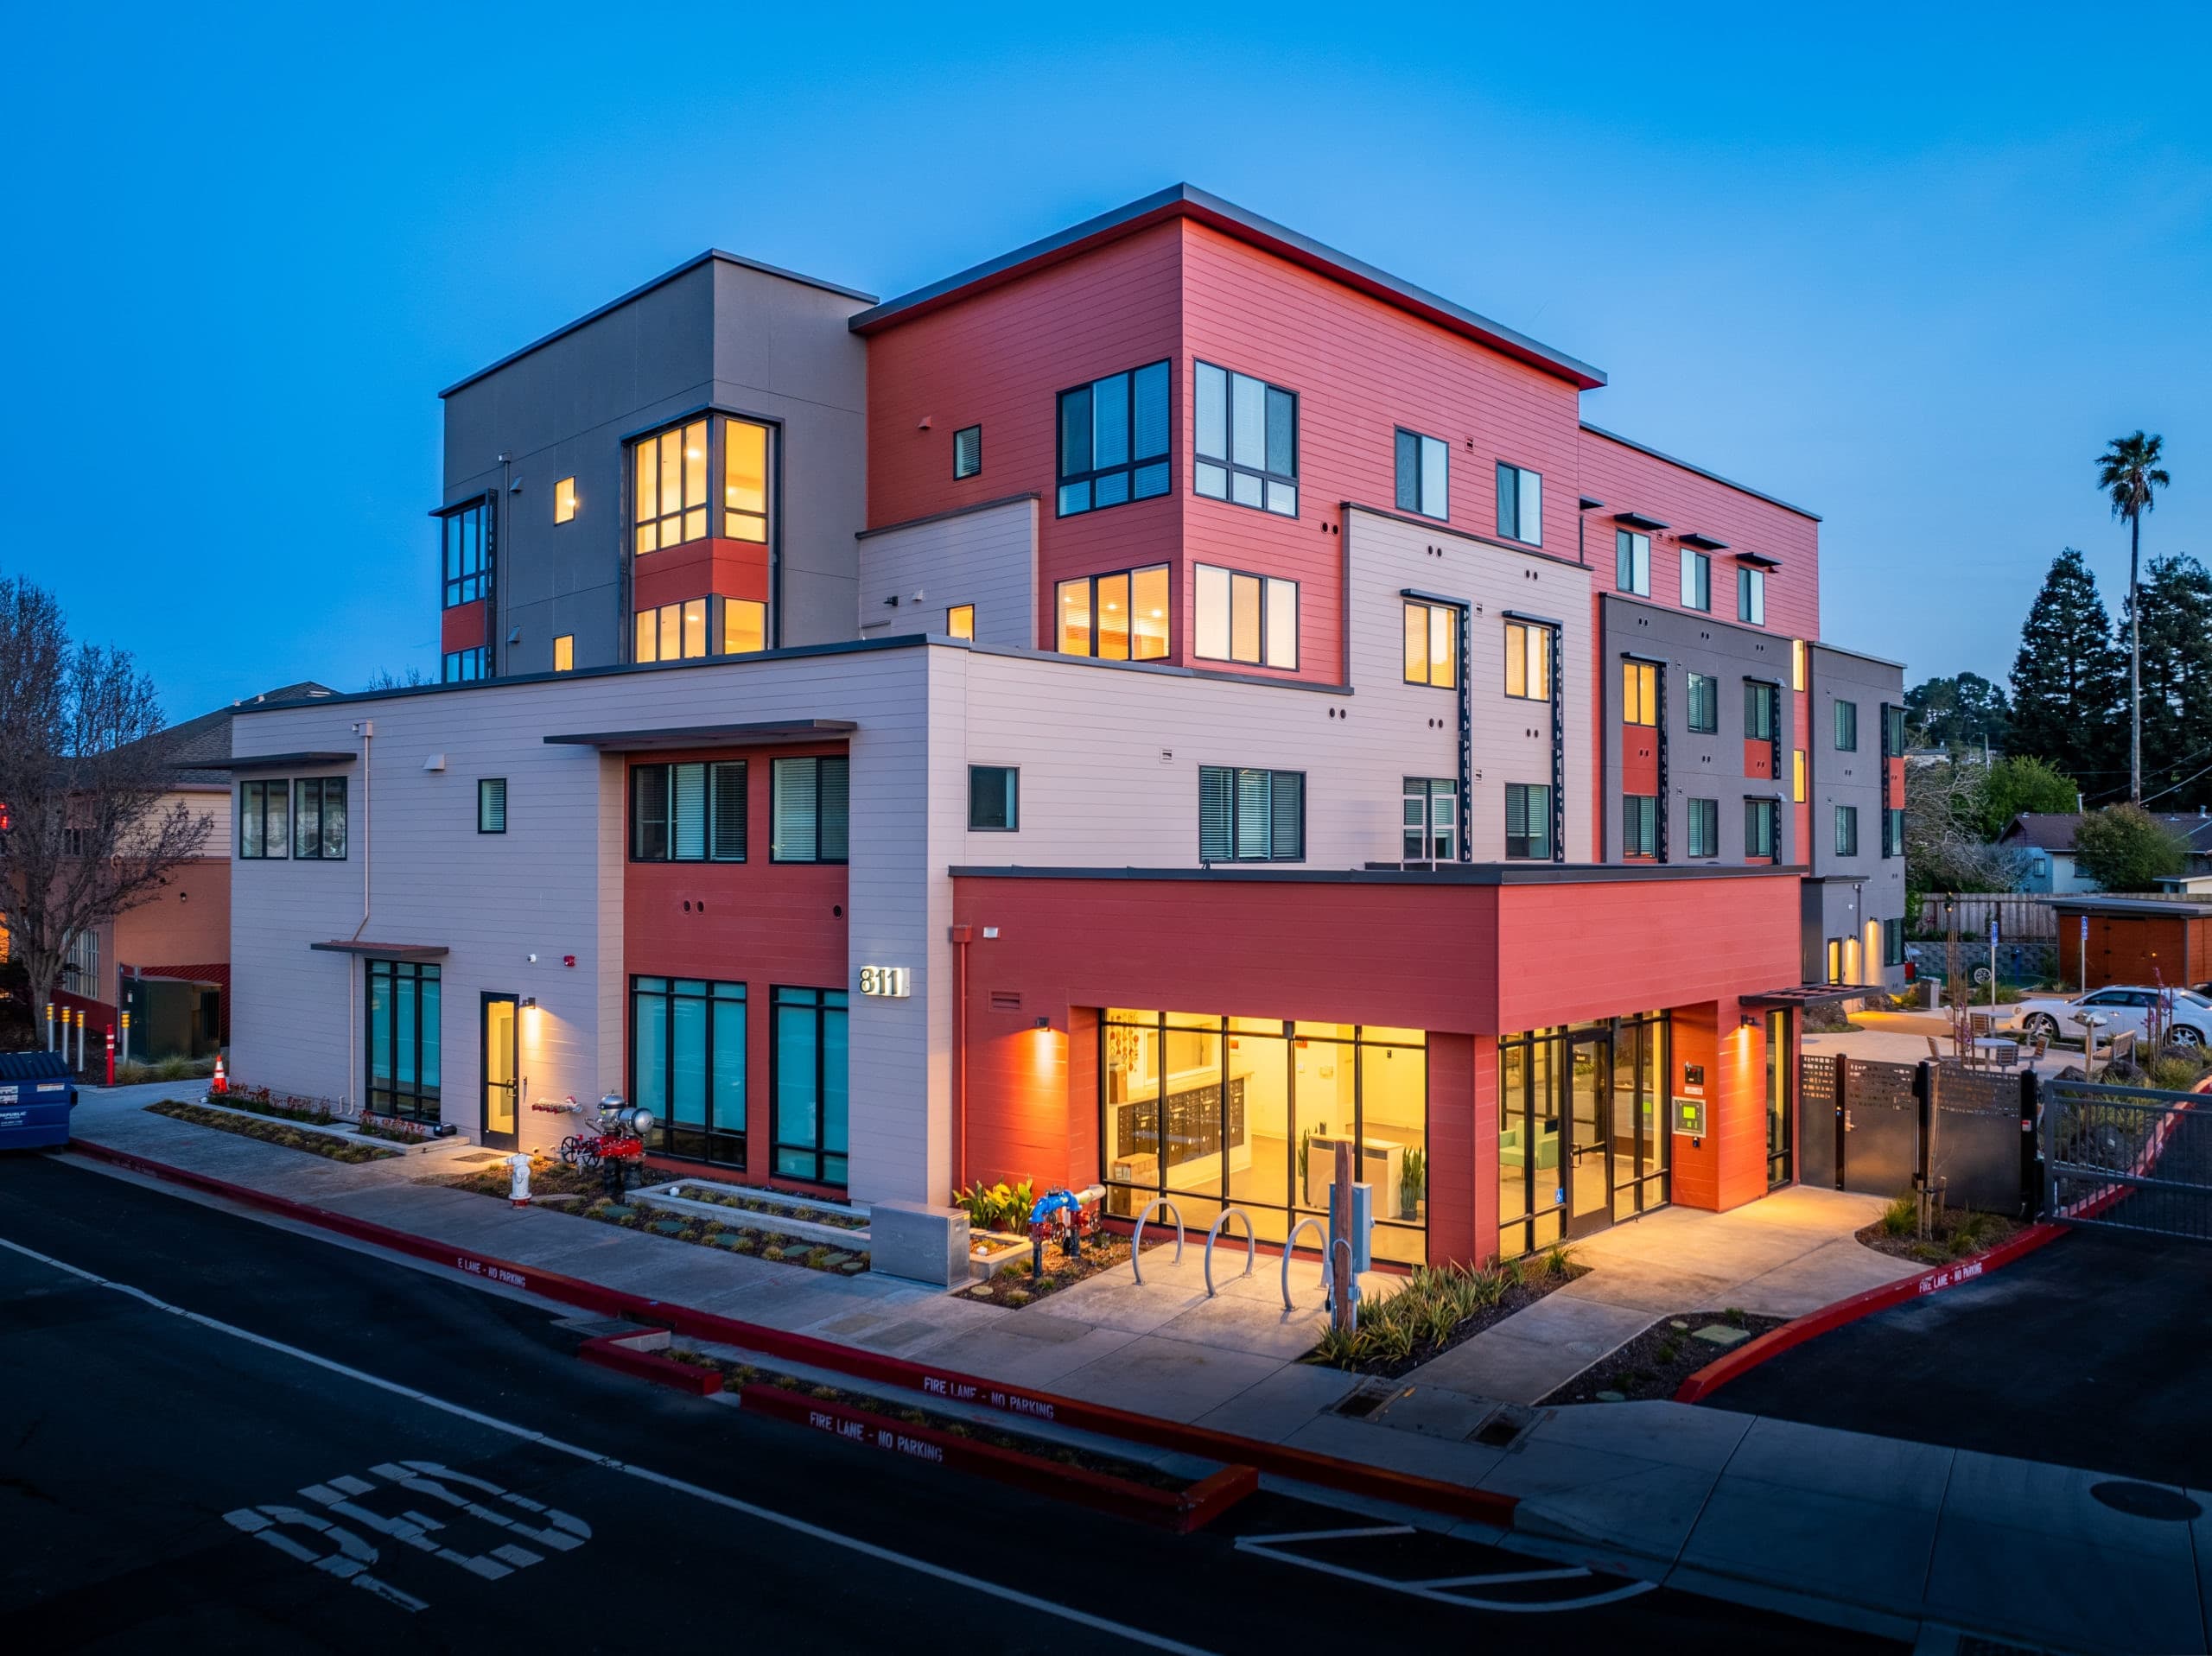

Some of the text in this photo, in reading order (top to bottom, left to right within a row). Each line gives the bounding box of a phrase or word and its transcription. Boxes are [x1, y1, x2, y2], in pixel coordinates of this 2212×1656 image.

[860, 968, 898, 995] 811
[465, 1259, 481, 1273] LANE
[488, 1266, 498, 1278] NO
[499, 1270, 526, 1287] PARKING
[1919, 1279, 1932, 1293] FIRE
[1934, 1273, 1948, 1288] LANE
[1955, 1270, 1962, 1281] NO
[1963, 1262, 1982, 1278] PARKING
[924, 1376, 947, 1394] FIRE
[950, 1382, 977, 1399] LANE
[991, 1391, 1006, 1408] NO
[1010, 1396, 1054, 1419] PARKING
[810, 1411, 832, 1431] FIRE
[836, 1418, 865, 1442] LANE
[878, 1430, 894, 1450] NO
[898, 1435, 944, 1463] PARKING
